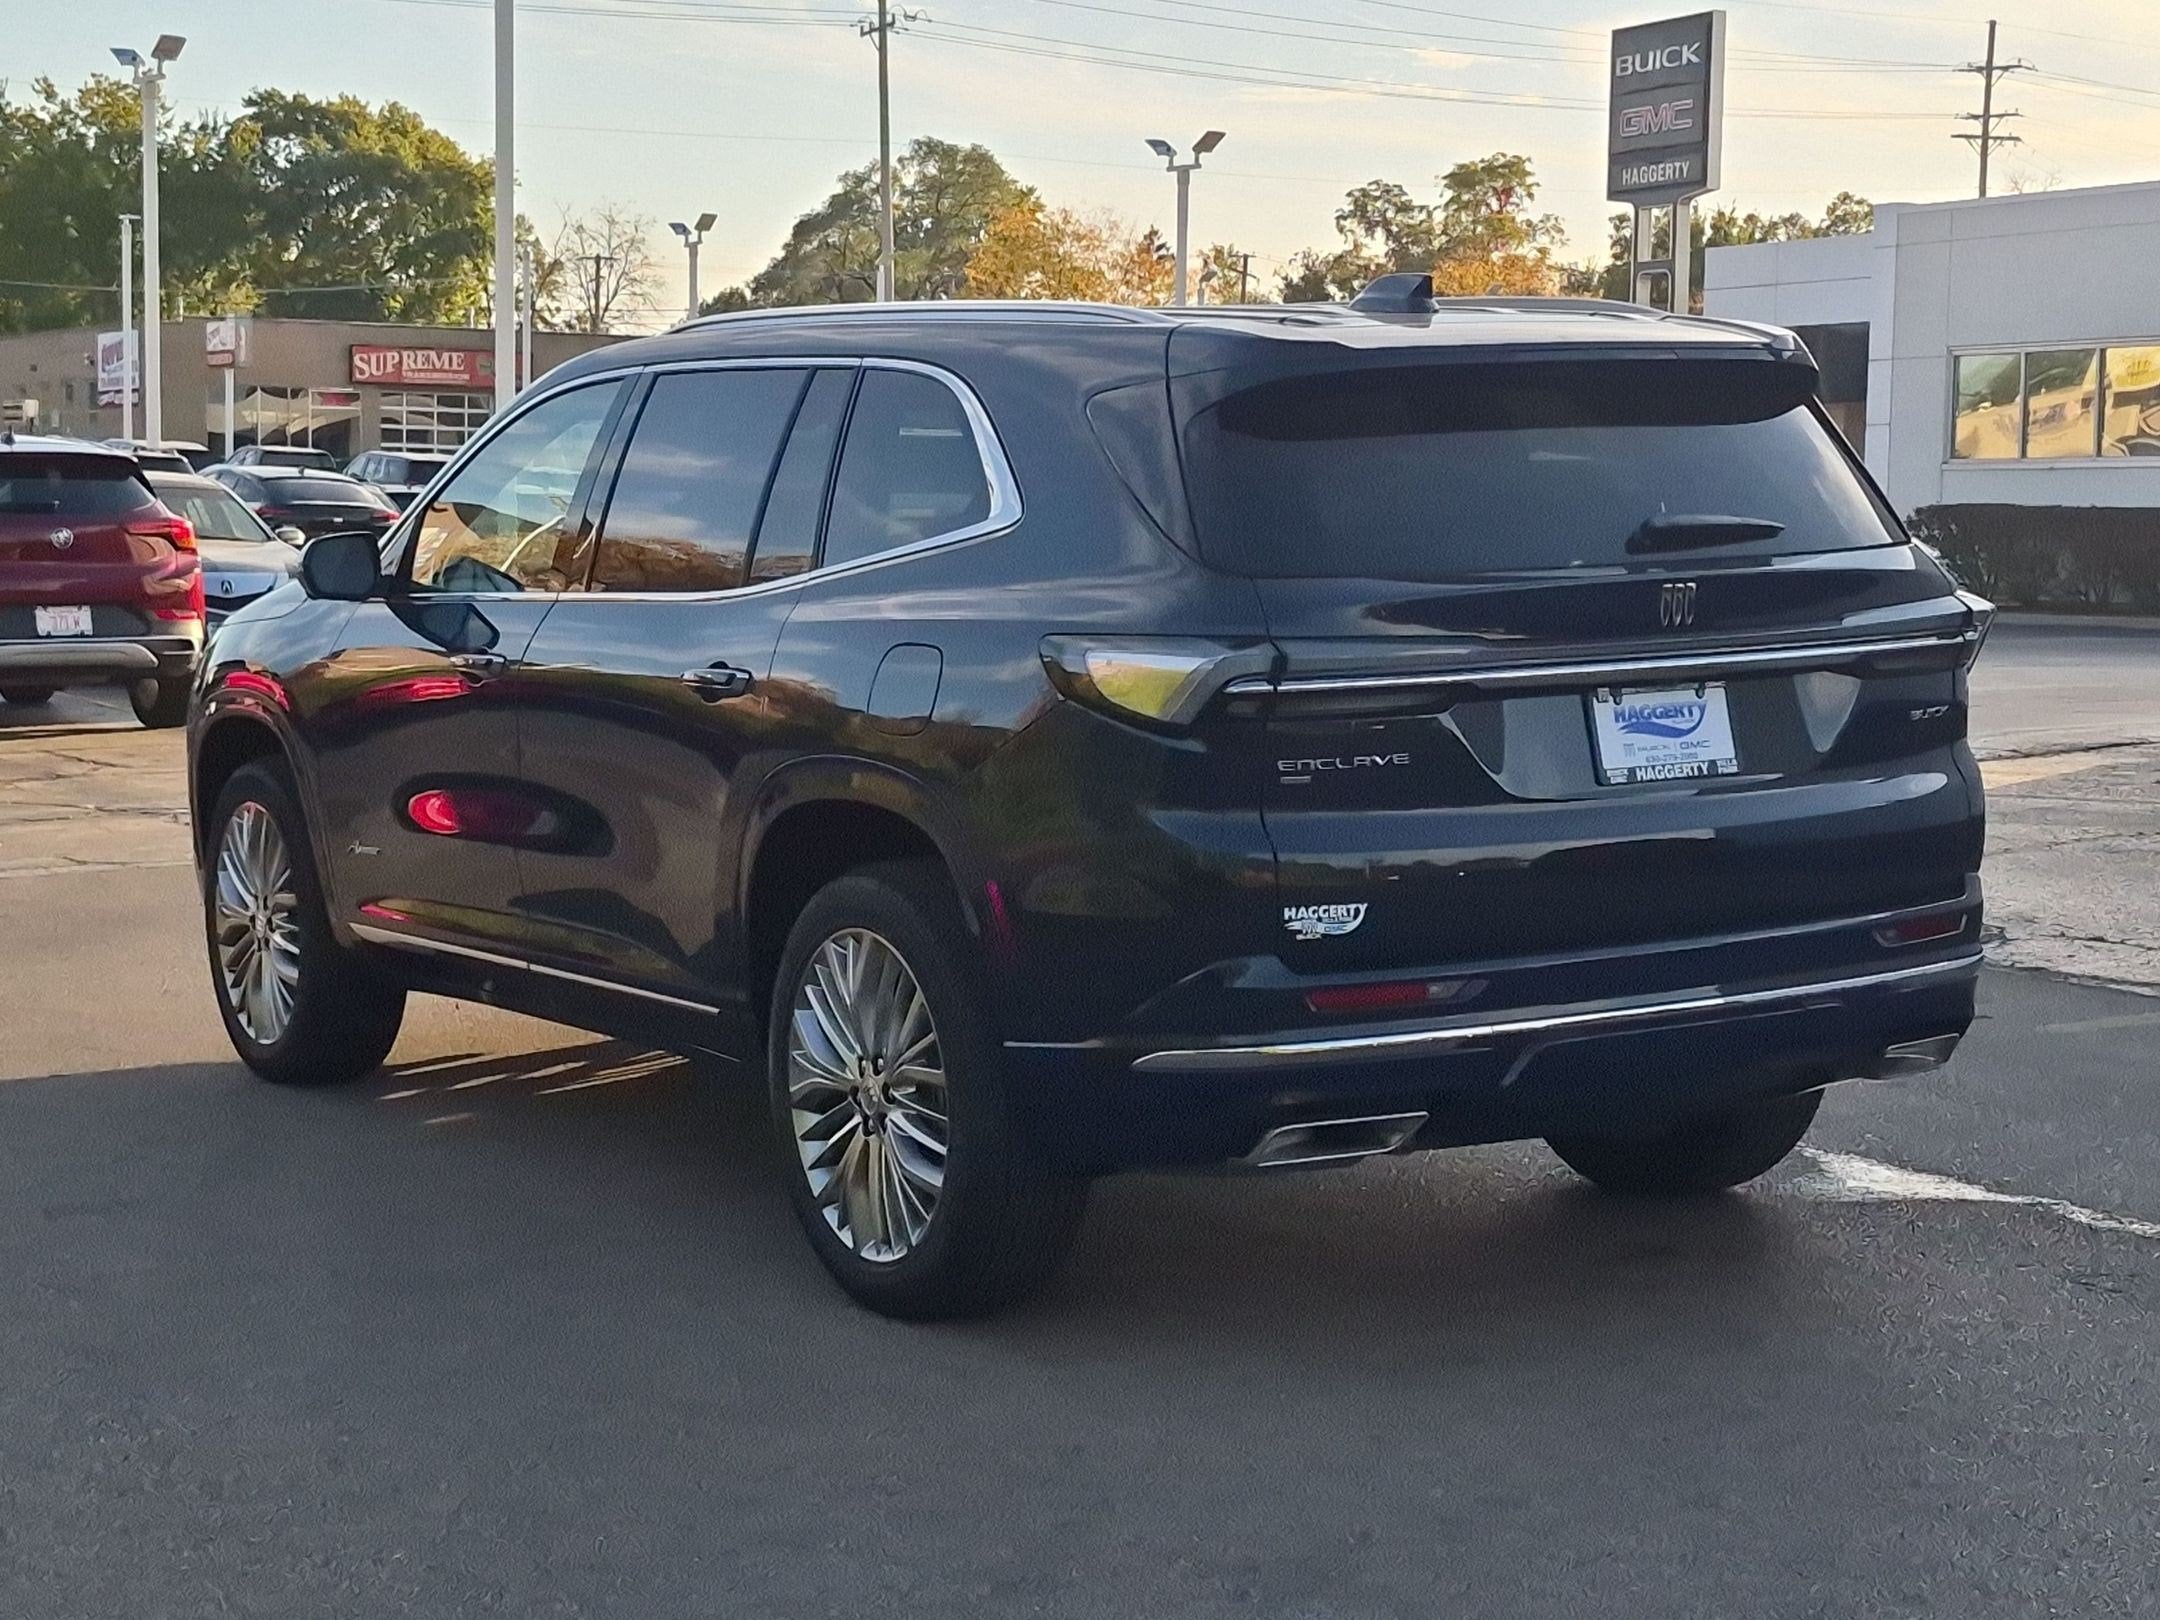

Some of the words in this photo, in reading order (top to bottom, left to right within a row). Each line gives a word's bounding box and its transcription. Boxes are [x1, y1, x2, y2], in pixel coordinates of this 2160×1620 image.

[1615, 42, 1702, 76] BUICK
[1620, 99, 1694, 137] GMC
[1622, 160, 1690, 186] HAGGERTY
[353, 349, 466, 379] SUPREME
[1613, 700, 1708, 724] HAGGERTY
[1680, 740, 1712, 750] GMC
[1277, 753, 1411, 772] ENCLAVE
[1635, 761, 1709, 782] HAGGERTY
[1284, 903, 1368, 921] HAGGERTY
